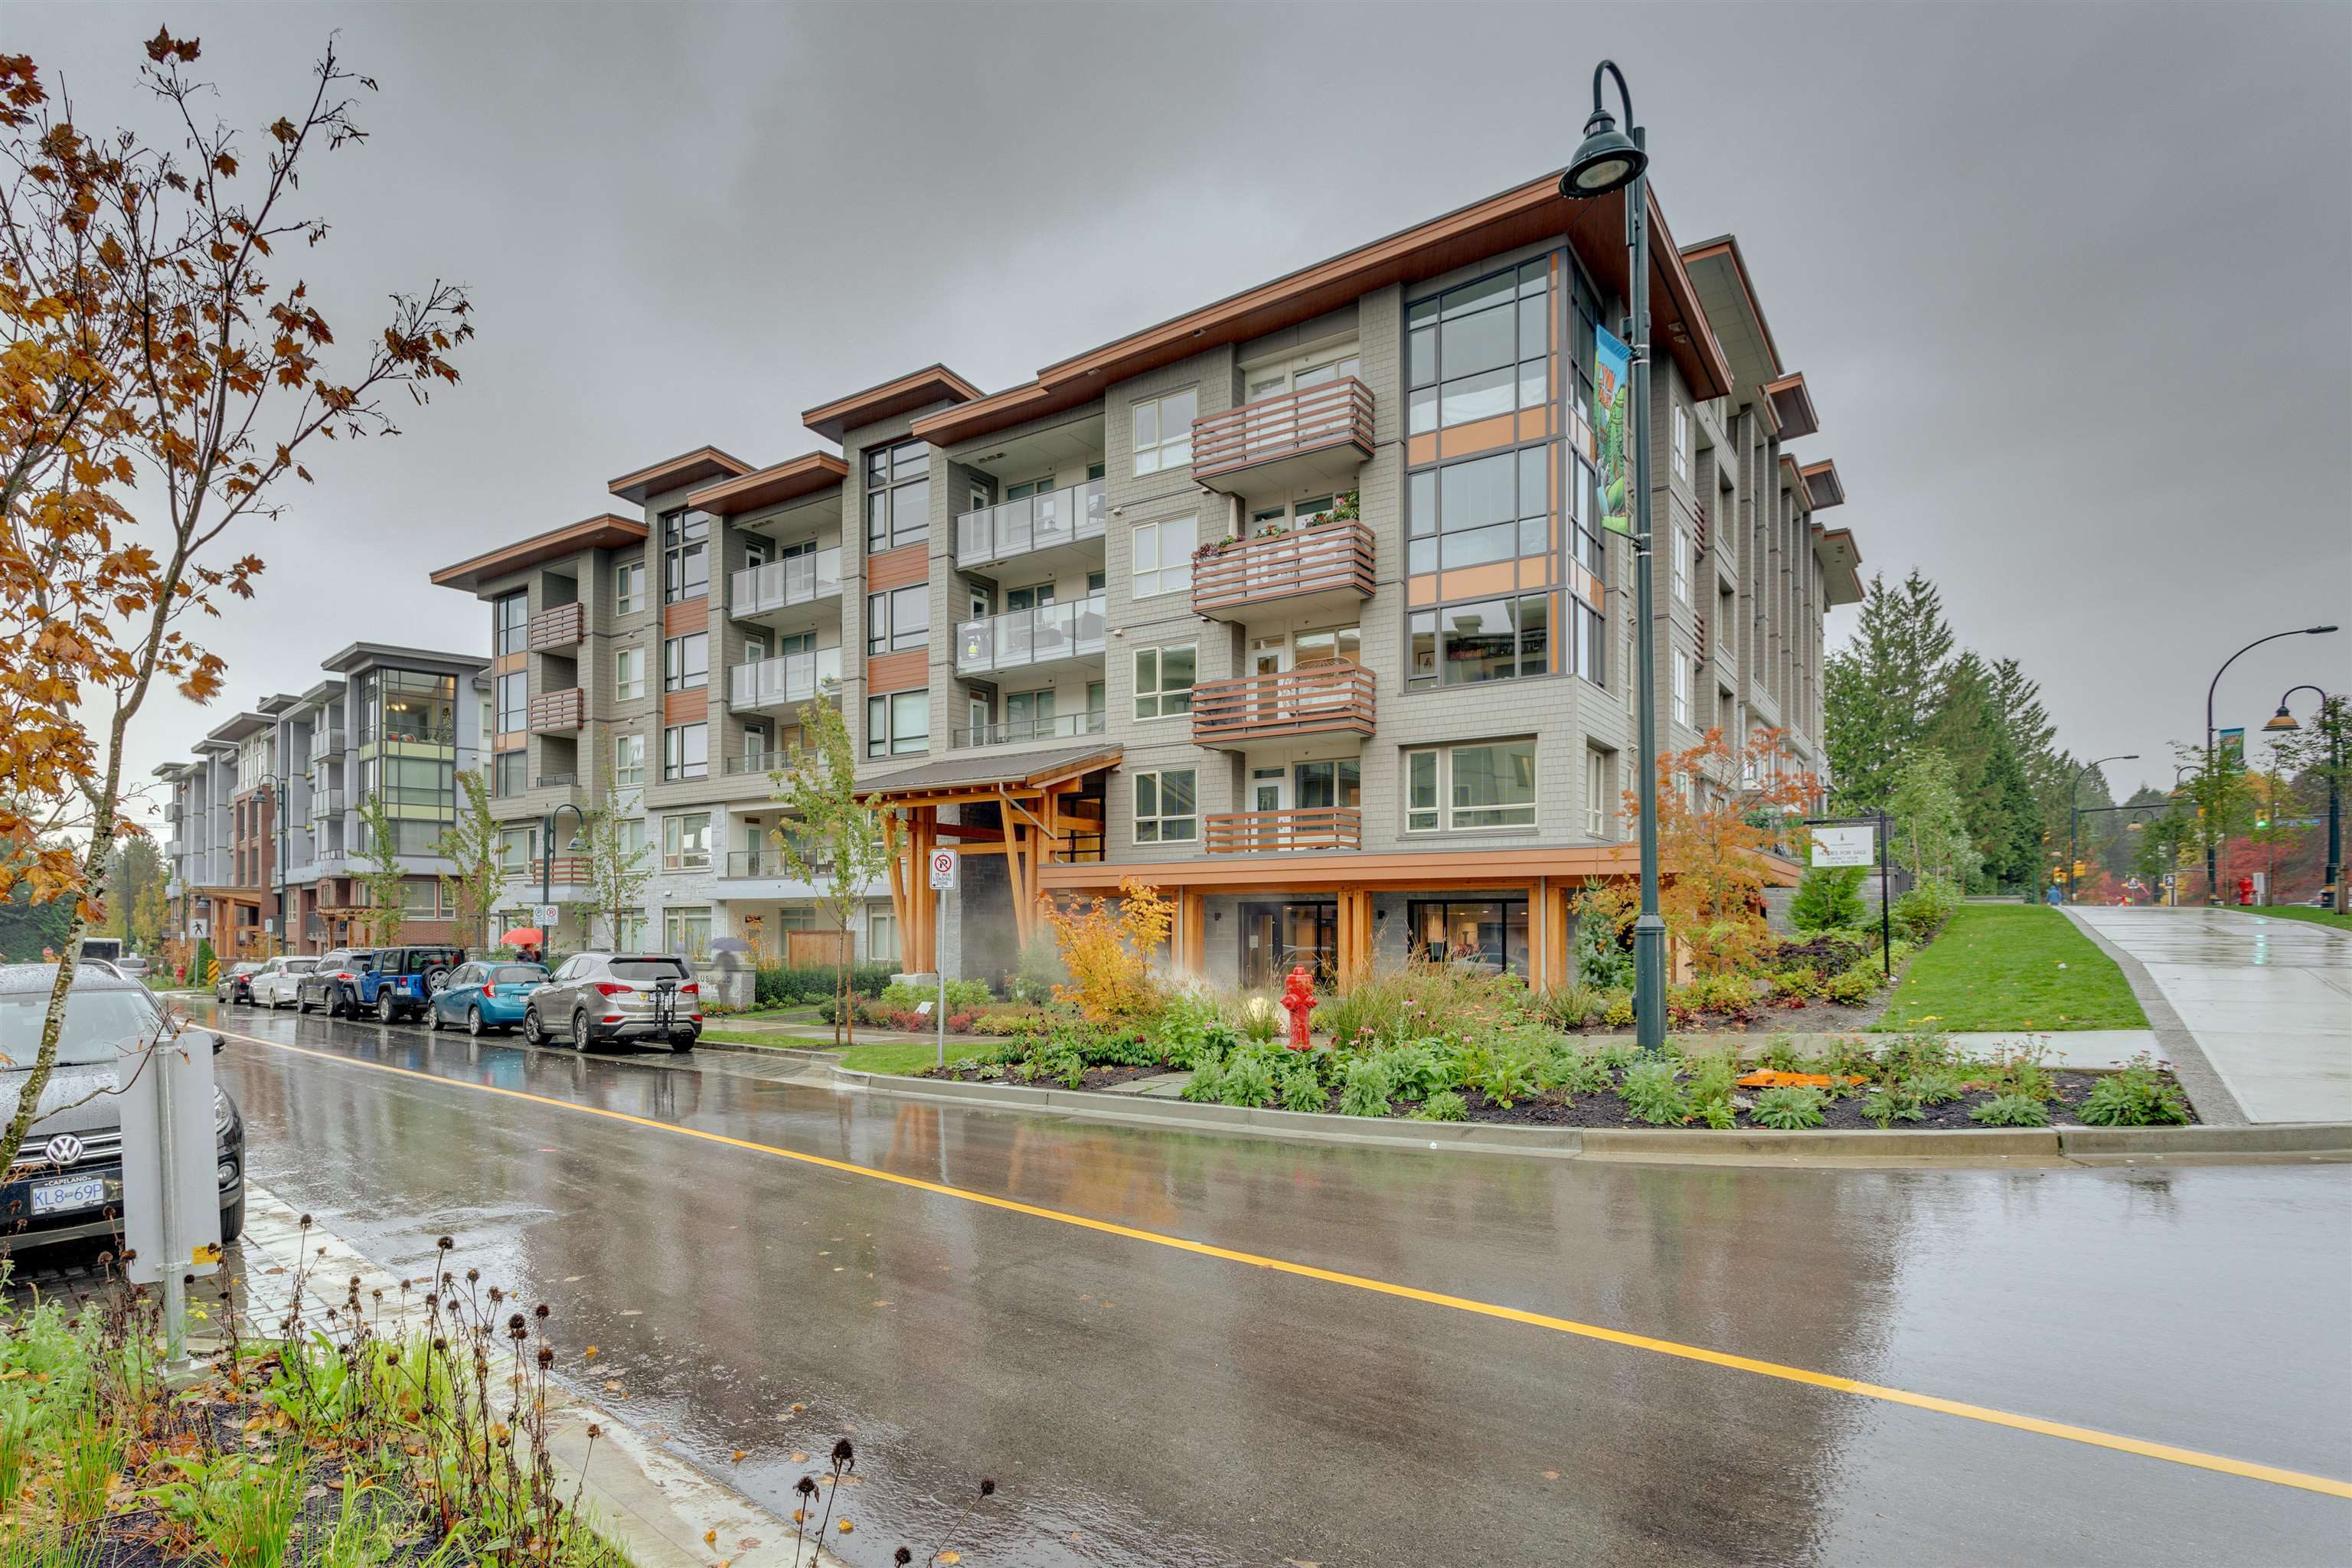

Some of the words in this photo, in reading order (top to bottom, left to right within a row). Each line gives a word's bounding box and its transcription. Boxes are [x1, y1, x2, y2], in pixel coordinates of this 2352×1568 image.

[48, 1175, 88, 1187] CAPILANO
[34, 1189, 65, 1207] KL8
[74, 1183, 103, 1200] 69P
